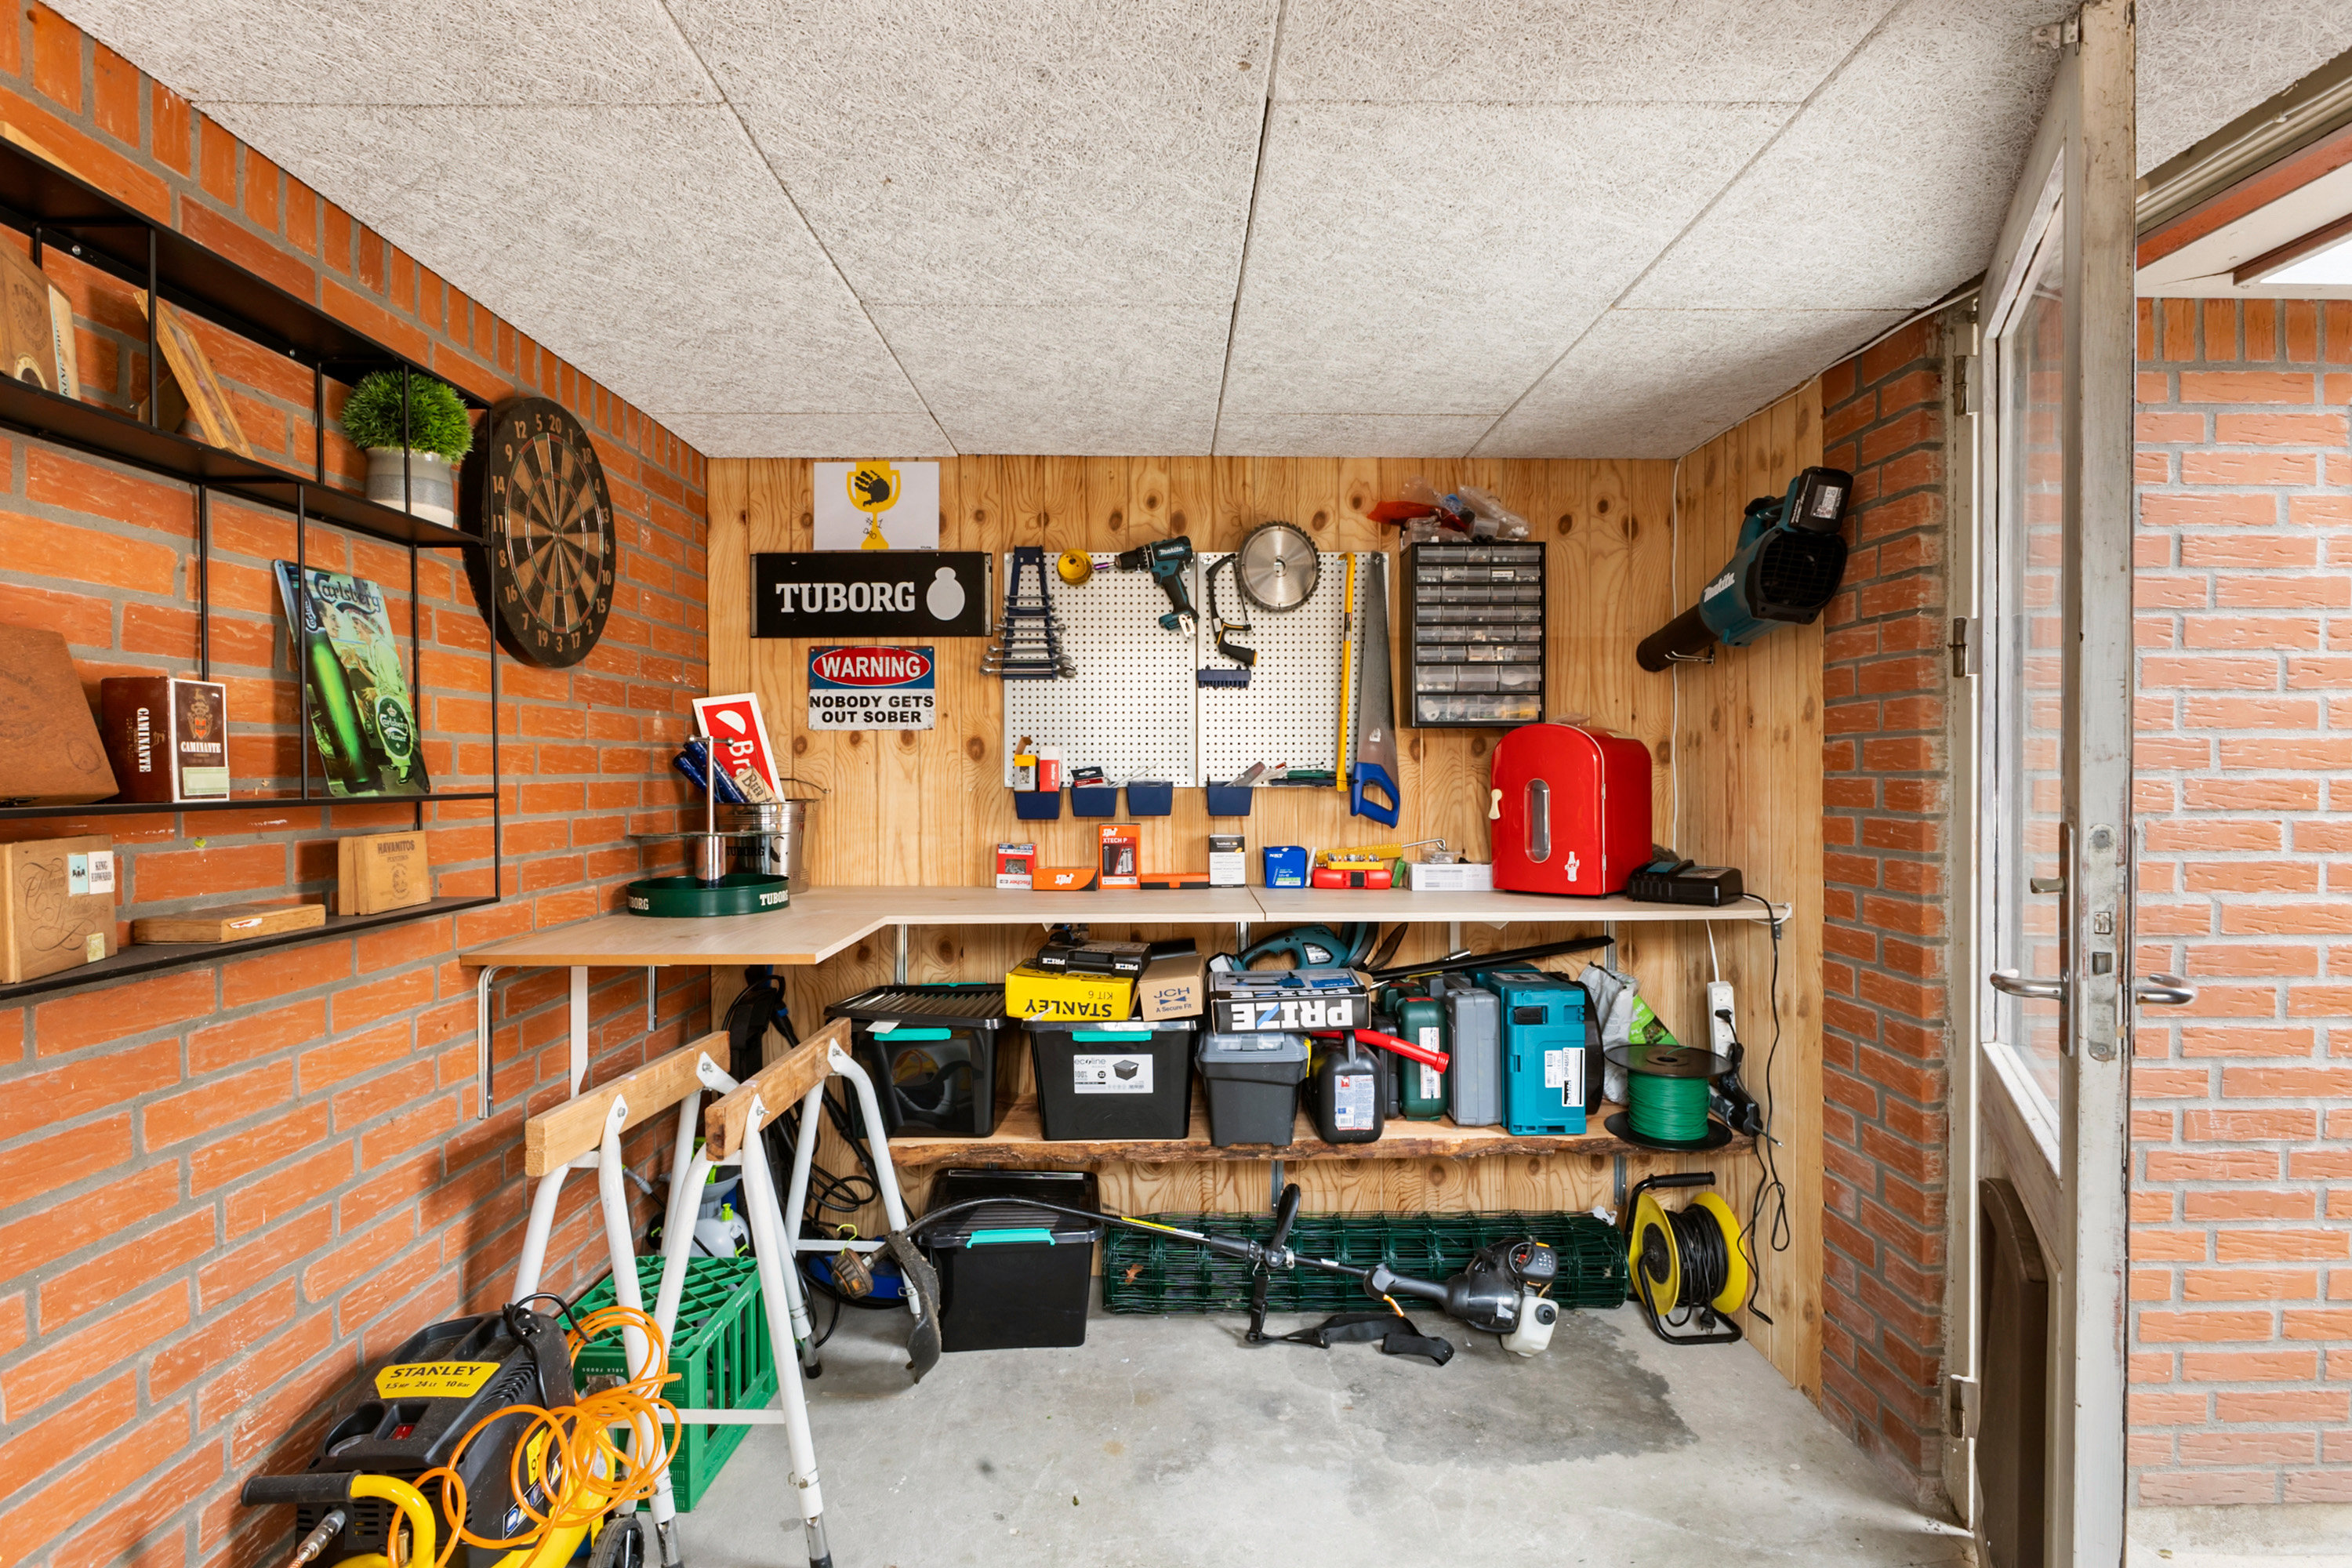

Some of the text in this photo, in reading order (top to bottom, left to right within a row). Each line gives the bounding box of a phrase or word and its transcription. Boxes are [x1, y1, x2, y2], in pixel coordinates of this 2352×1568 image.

[514, 421, 527, 439] 12
[535, 414, 543, 431] 5
[549, 415, 562, 434] 20
[568, 429, 573, 445] 1
[505, 444, 513, 462] 9
[582, 448, 592, 464] 18
[493, 476, 505, 494] 14
[594, 478, 601, 493] 4
[493, 514, 503, 533] 11
[601, 508, 609, 524] 13
[604, 539, 610, 554] 6
[499, 550, 507, 568] 8
[602, 570, 611, 586] 10
[314, 572, 382, 614] Carlsberg
[505, 584, 517, 603] 16
[775, 582, 916, 613] TUBORG
[597, 598, 606, 614] 15
[522, 613, 528, 630] 7
[586, 619, 593, 635] 2
[538, 630, 549, 647] 19
[556, 636, 563, 652] 3
[571, 632, 580, 648] 17
[822, 657, 921, 678] WARNING
[810, 695, 934, 708] NOBODY GETS
[822, 711, 922, 723] OUT SOBER
[137, 707, 151, 772] CAMINANTE
[180, 741, 221, 753] CAMINANTE
[742, 773, 764, 798] BEER
[377, 840, 416, 854] HAVANITOS
[95, 860, 107, 870] KING
[1043, 957, 1065, 966] PRIZE
[1088, 990, 1094, 999] 6
[1154, 987, 1190, 999] JCH
[1025, 999, 1112, 1018] STANLEY
[1230, 999, 1353, 1031] PRIZE
[390, 1366, 482, 1378] STANLEY
